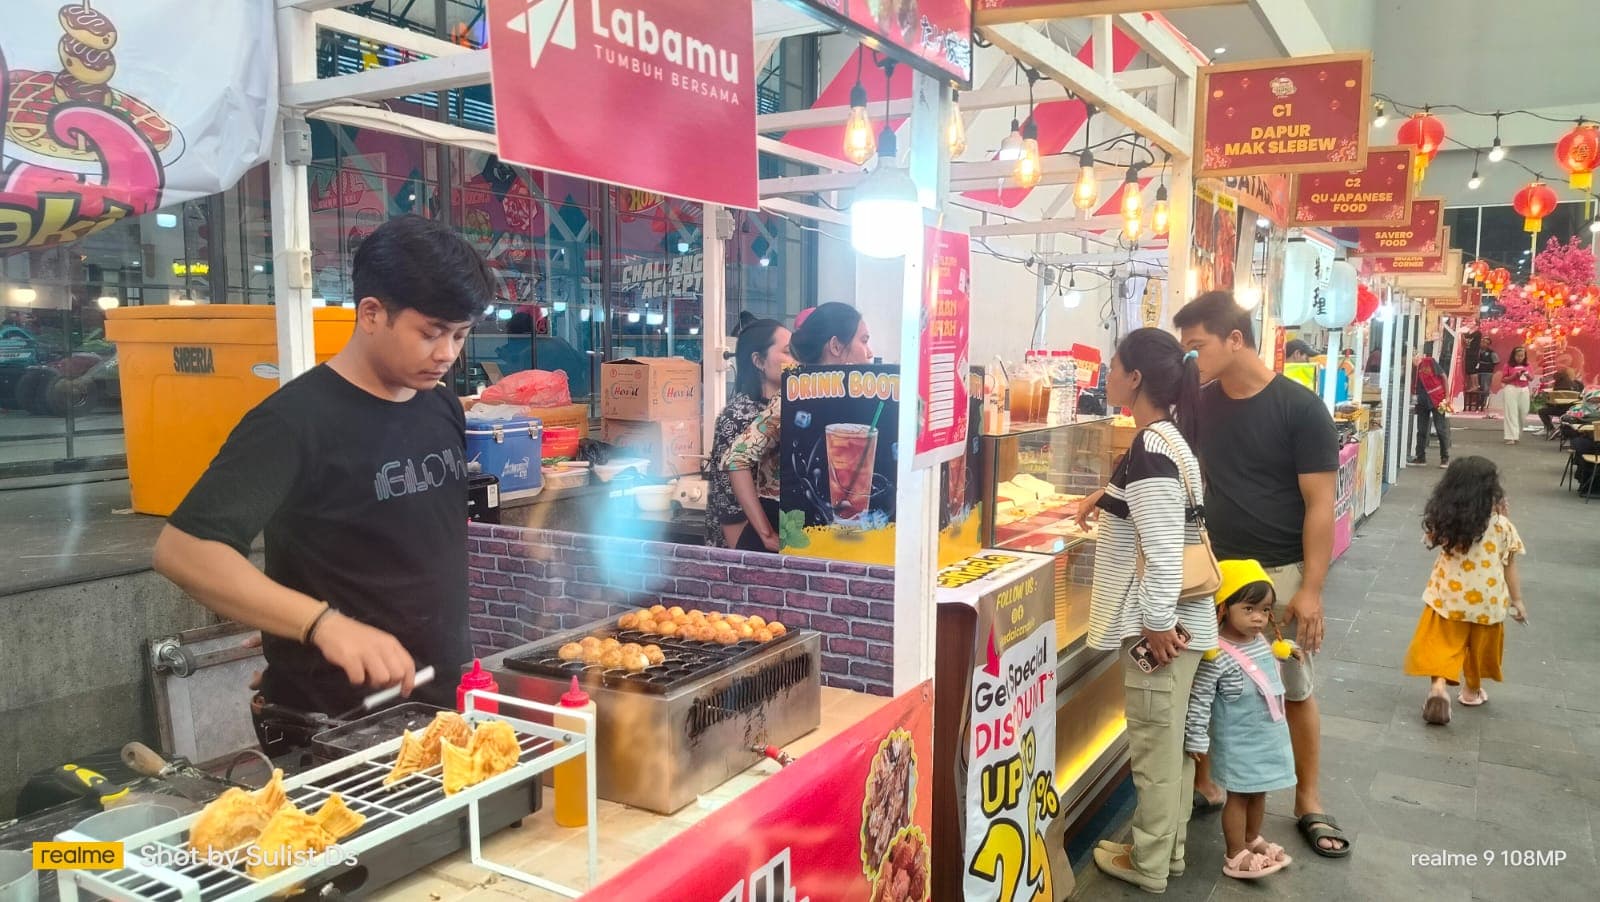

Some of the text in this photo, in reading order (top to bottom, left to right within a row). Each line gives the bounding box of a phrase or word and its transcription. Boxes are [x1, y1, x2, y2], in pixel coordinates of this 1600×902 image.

[591, 0, 739, 84] Labamu
[594, 44, 739, 105] TUMBUH BERSAMA
[1272, 103, 1292, 118] C1
[1250, 124, 1311, 140] DAPUR
[1225, 137, 1336, 156] MAK SLEBEW
[1344, 177, 1361, 187] C2
[1311, 192, 1393, 204] QU JAPANESE
[1333, 203, 1368, 213] FOOD
[1375, 231, 1414, 240] SAVERO
[1379, 238, 1407, 247] FOOD
[786, 371, 846, 402] DRINK
[996, 589, 1025, 612] FOLLOW
[1009, 636, 1047, 694] Special
[981, 753, 1023, 819] UP
